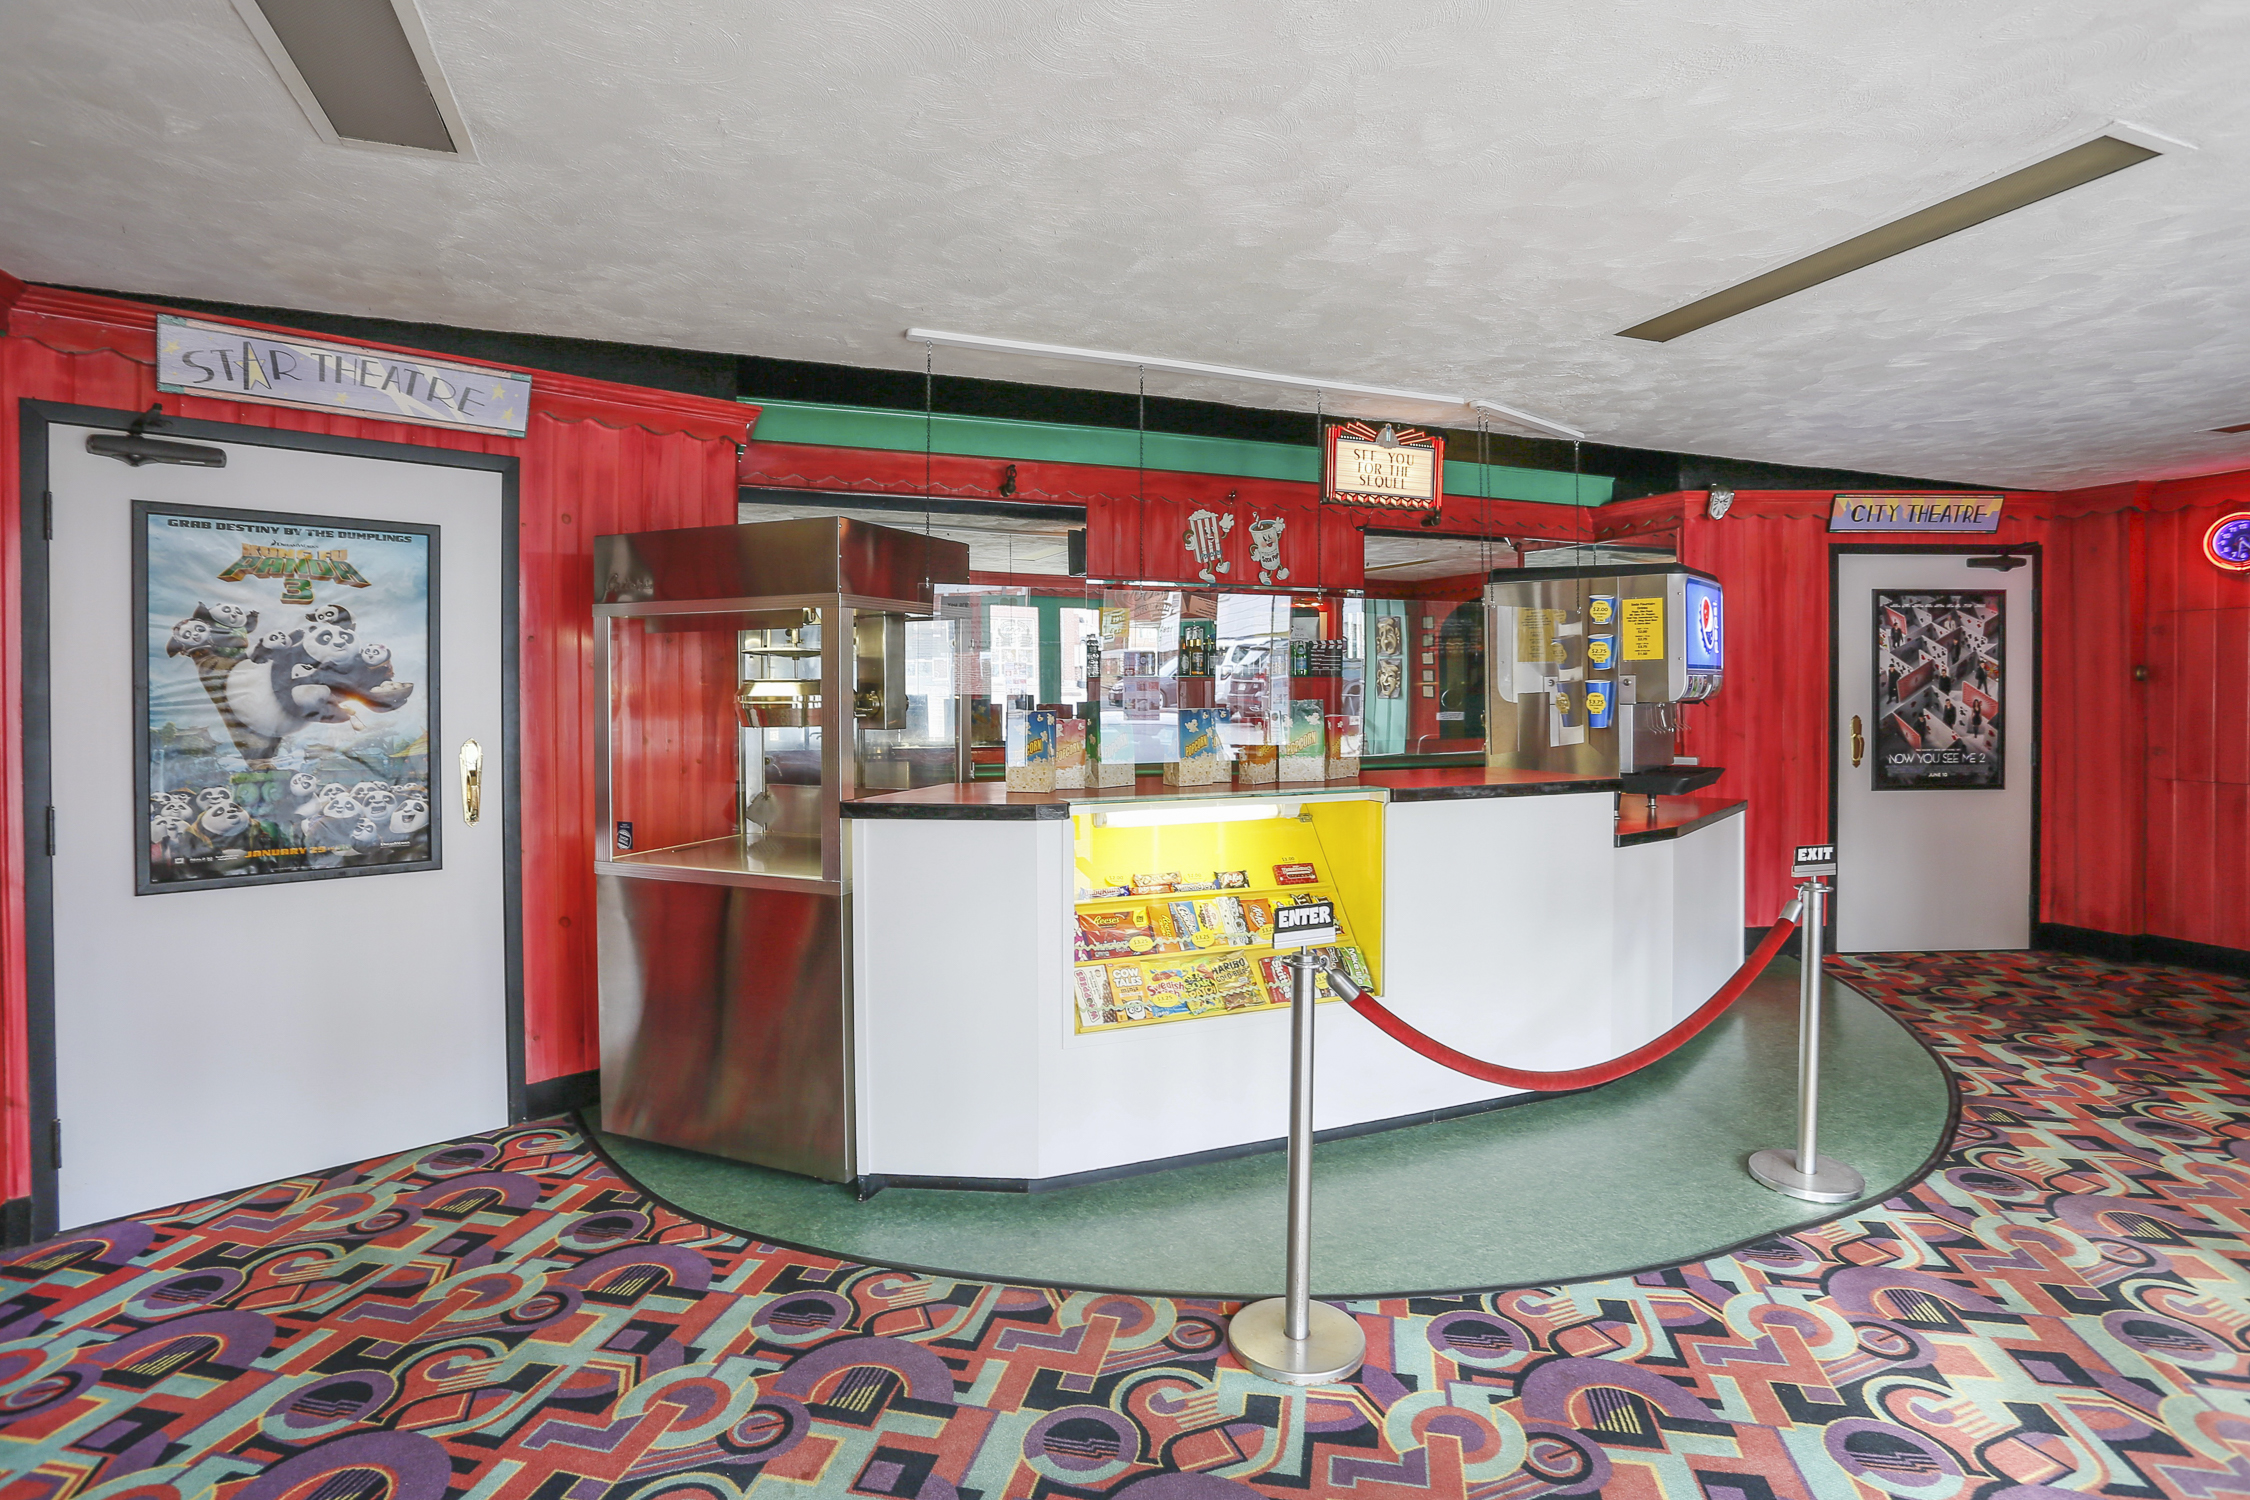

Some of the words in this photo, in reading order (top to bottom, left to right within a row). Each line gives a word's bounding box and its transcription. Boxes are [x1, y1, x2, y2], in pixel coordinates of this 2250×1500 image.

[182, 341, 302, 391] STAR
[311, 352, 486, 417] THEATRE
[1353, 449, 1377, 461] SEE
[1388, 452, 1415, 466] YOU
[1357, 461, 1382, 475] FOR
[1389, 465, 1411, 477] THE
[1359, 474, 1407, 489] SEQUEL
[1851, 504, 1900, 523] CITY
[1908, 504, 1988, 524] THEATRE
[167, 518, 212, 530] GRAB
[216, 522, 280, 535] DESTINY
[284, 528, 302, 536] BY
[305, 529, 334, 539] THE
[338, 531, 412, 543] DUMPLINGS
[241, 543, 313, 559] KUNG
[316, 550, 348, 561] FU
[217, 555, 372, 588] PANDA
[280, 578, 315, 605] 3
[1185, 734, 1209, 757] POPCORN
[1287, 731, 1317, 756] POPCORN
[1888, 753, 1916, 764] NOW
[1917, 753, 1940, 764] YOU
[1942, 752, 1959, 764] SEE
[1961, 752, 1976, 763] ME
[1979, 752, 1986, 763] 2
[244, 847, 307, 858] JANUARY
[310, 846, 327, 854] 29
[1797, 846, 1834, 862] EXIT
[1278, 905, 1332, 929] ENTER
[1211, 957, 1246, 976] HARIBO
[1348, 947, 1361, 971] Mike
[1112, 968, 1139, 979] COW
[1113, 976, 1143, 988] TALES
[1271, 960, 1292, 998] Skittes
[1146, 980, 1186, 997] Swedish
[1184, 978, 1212, 992] SOUR
